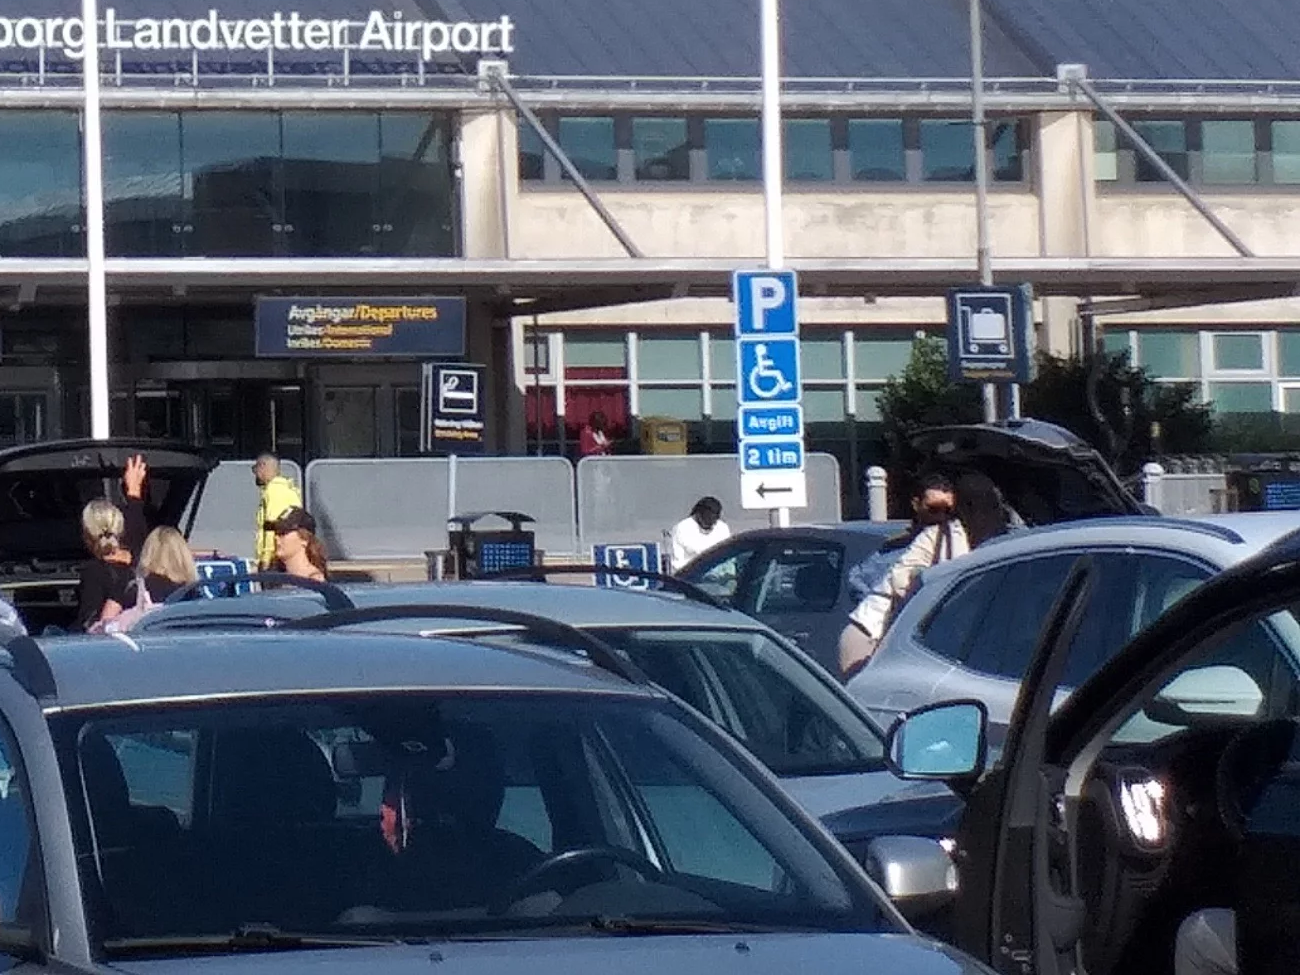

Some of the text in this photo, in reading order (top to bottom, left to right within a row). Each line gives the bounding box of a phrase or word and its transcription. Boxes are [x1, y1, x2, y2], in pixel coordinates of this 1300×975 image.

[105, 8, 349, 51] Landvetter
[359, 11, 514, 61] Airport
[750, 276, 786, 330] P
[748, 413, 794, 432] Avgift
[748, 446, 798, 466] 2 tim
